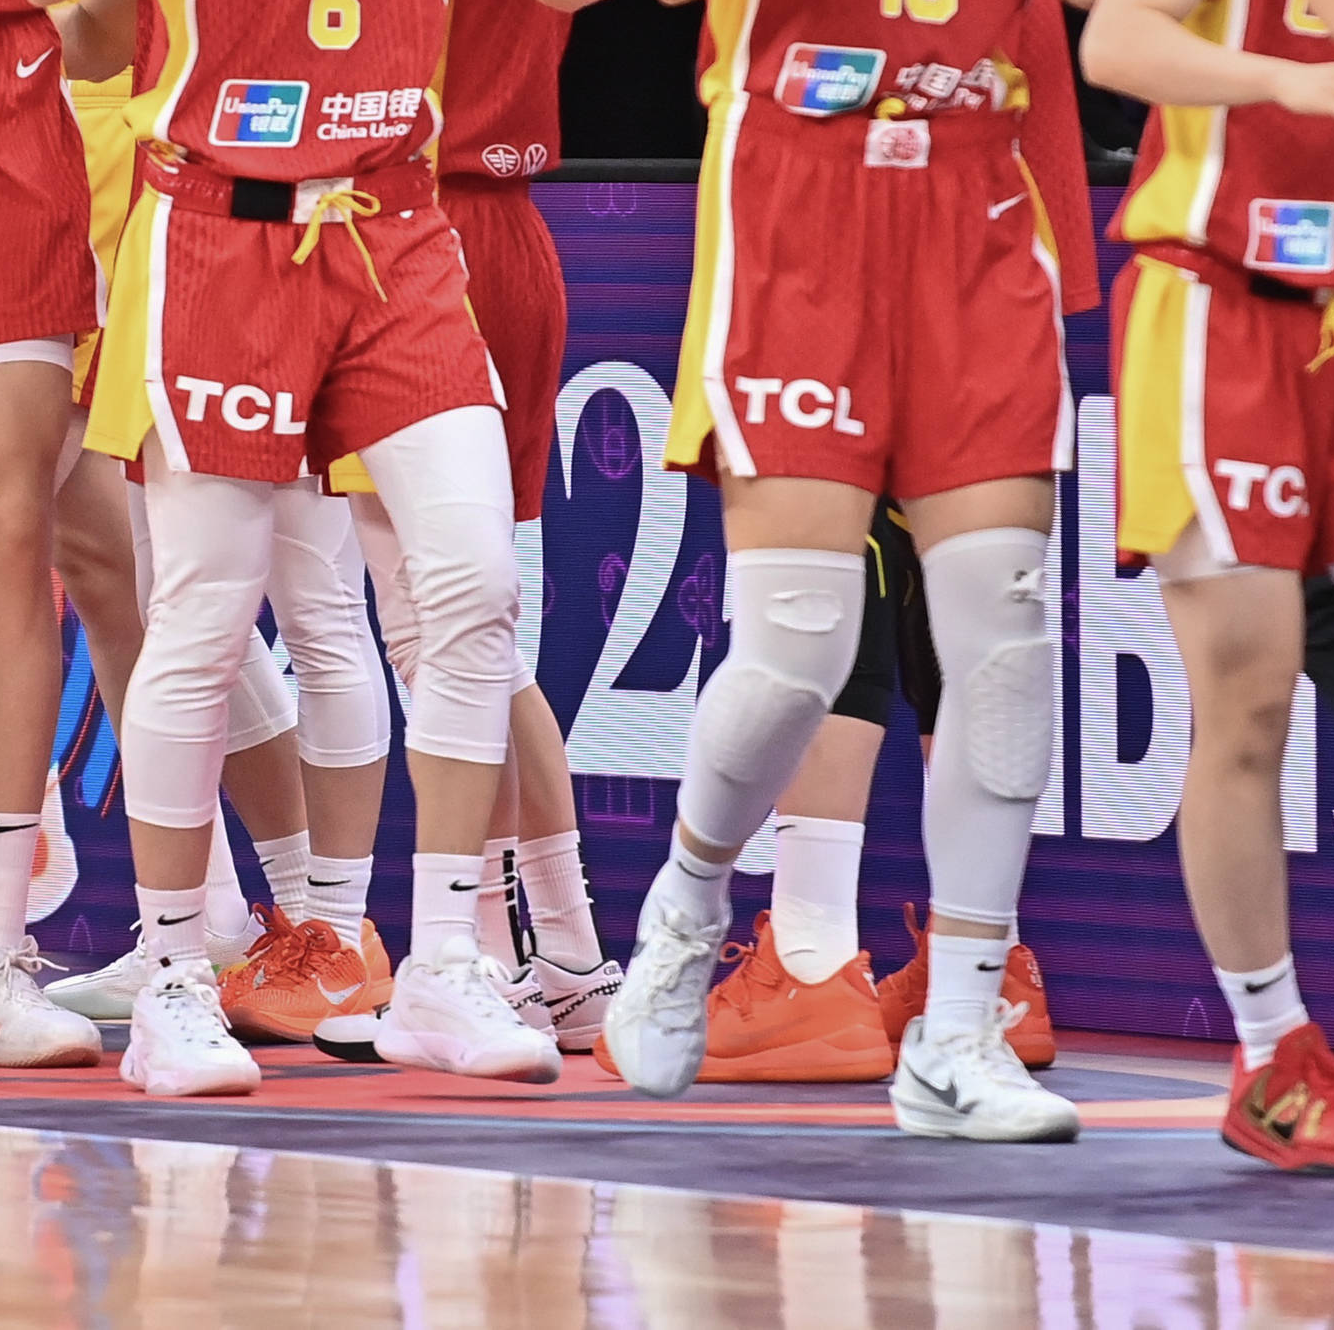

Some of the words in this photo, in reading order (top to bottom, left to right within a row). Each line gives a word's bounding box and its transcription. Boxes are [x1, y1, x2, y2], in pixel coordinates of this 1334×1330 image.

[317, 123, 367, 141] China
[174, 374, 307, 436] TCL
[735, 375, 865, 437] TCL
[1214, 458, 1310, 519] TC
